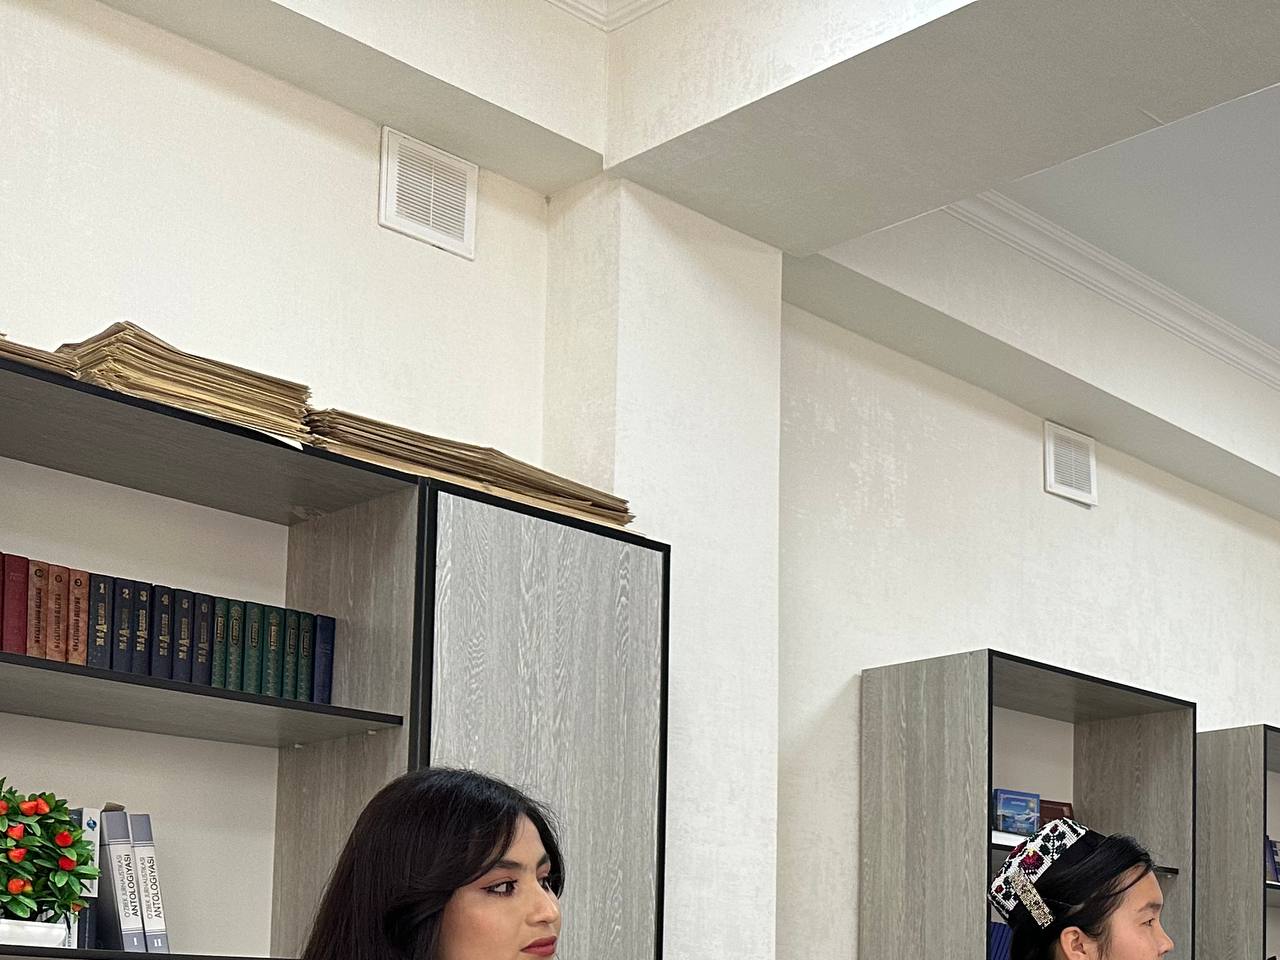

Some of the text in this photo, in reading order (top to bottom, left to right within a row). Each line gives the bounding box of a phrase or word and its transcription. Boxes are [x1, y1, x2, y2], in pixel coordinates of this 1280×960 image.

[99, 583, 105, 594] 1
[122, 588, 129, 599] 2
[140, 591, 147, 601] 3
[161, 594, 169, 605] 4
[182, 599, 189, 609] 5
[124, 854, 139, 917] ANTOLOGIYASI
[147, 856, 162, 919] ANTOLOGIYASI
